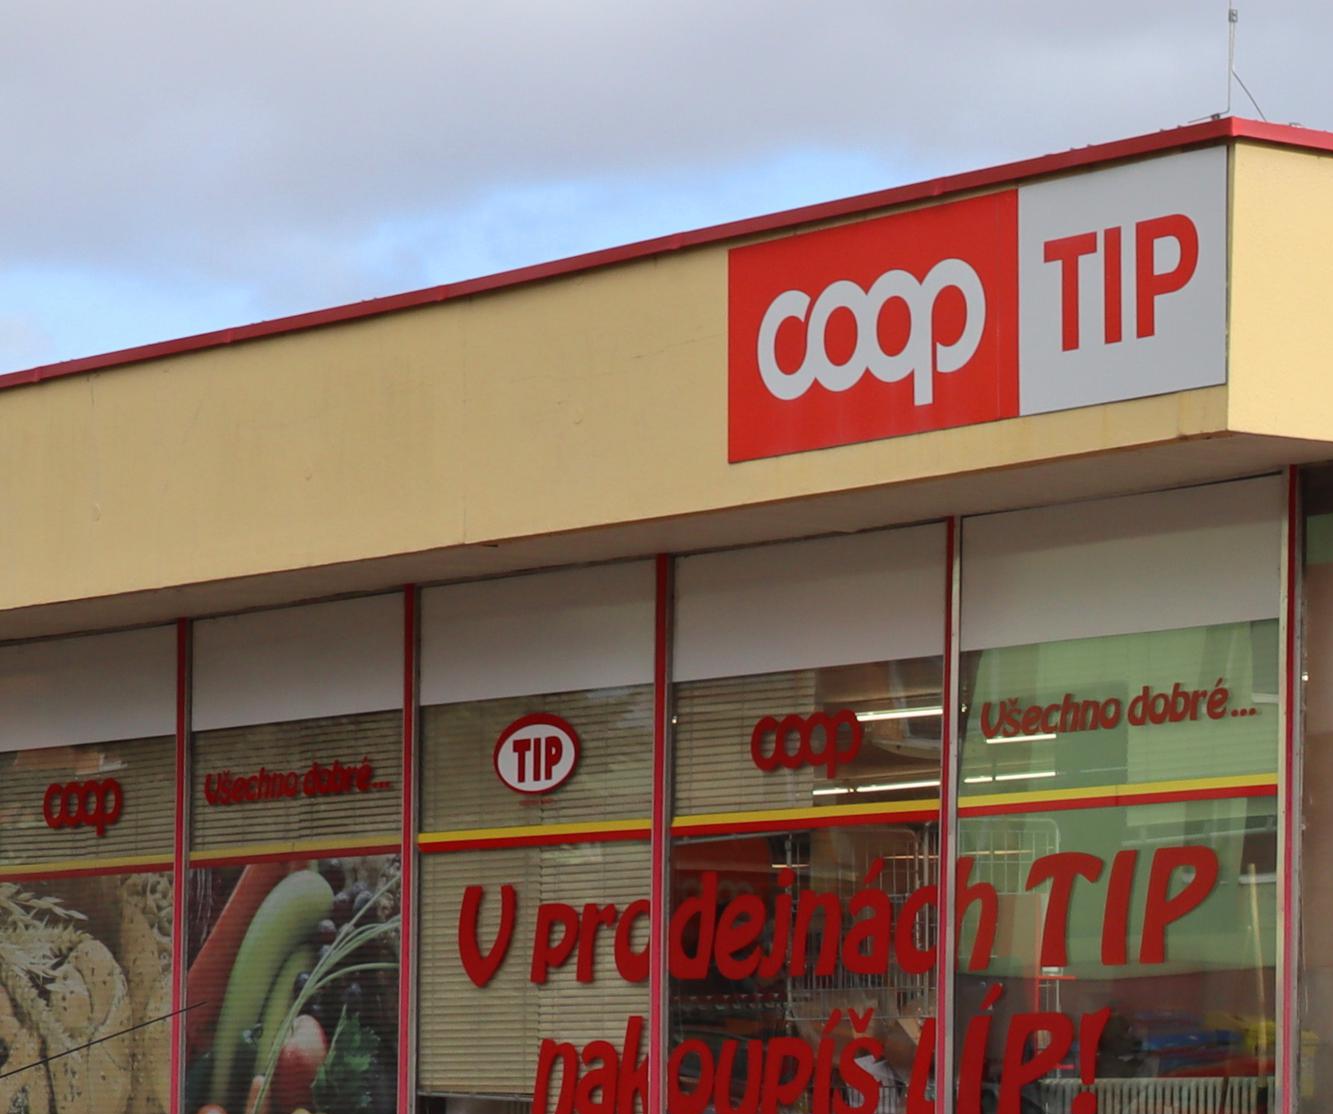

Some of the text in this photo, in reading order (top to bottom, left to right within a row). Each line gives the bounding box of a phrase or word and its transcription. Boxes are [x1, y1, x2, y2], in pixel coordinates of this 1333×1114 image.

[756, 214, 1199, 406] coop TIP
[751, 708, 864, 780] coop
[980, 692, 1119, 739] Všechno
[204, 767, 298, 806] Všechno
[513, 736, 563, 783] TIP
[43, 777, 123, 837] coop
[530, 856, 999, 985] prodejnách
[1025, 845, 1219, 967] TIP
